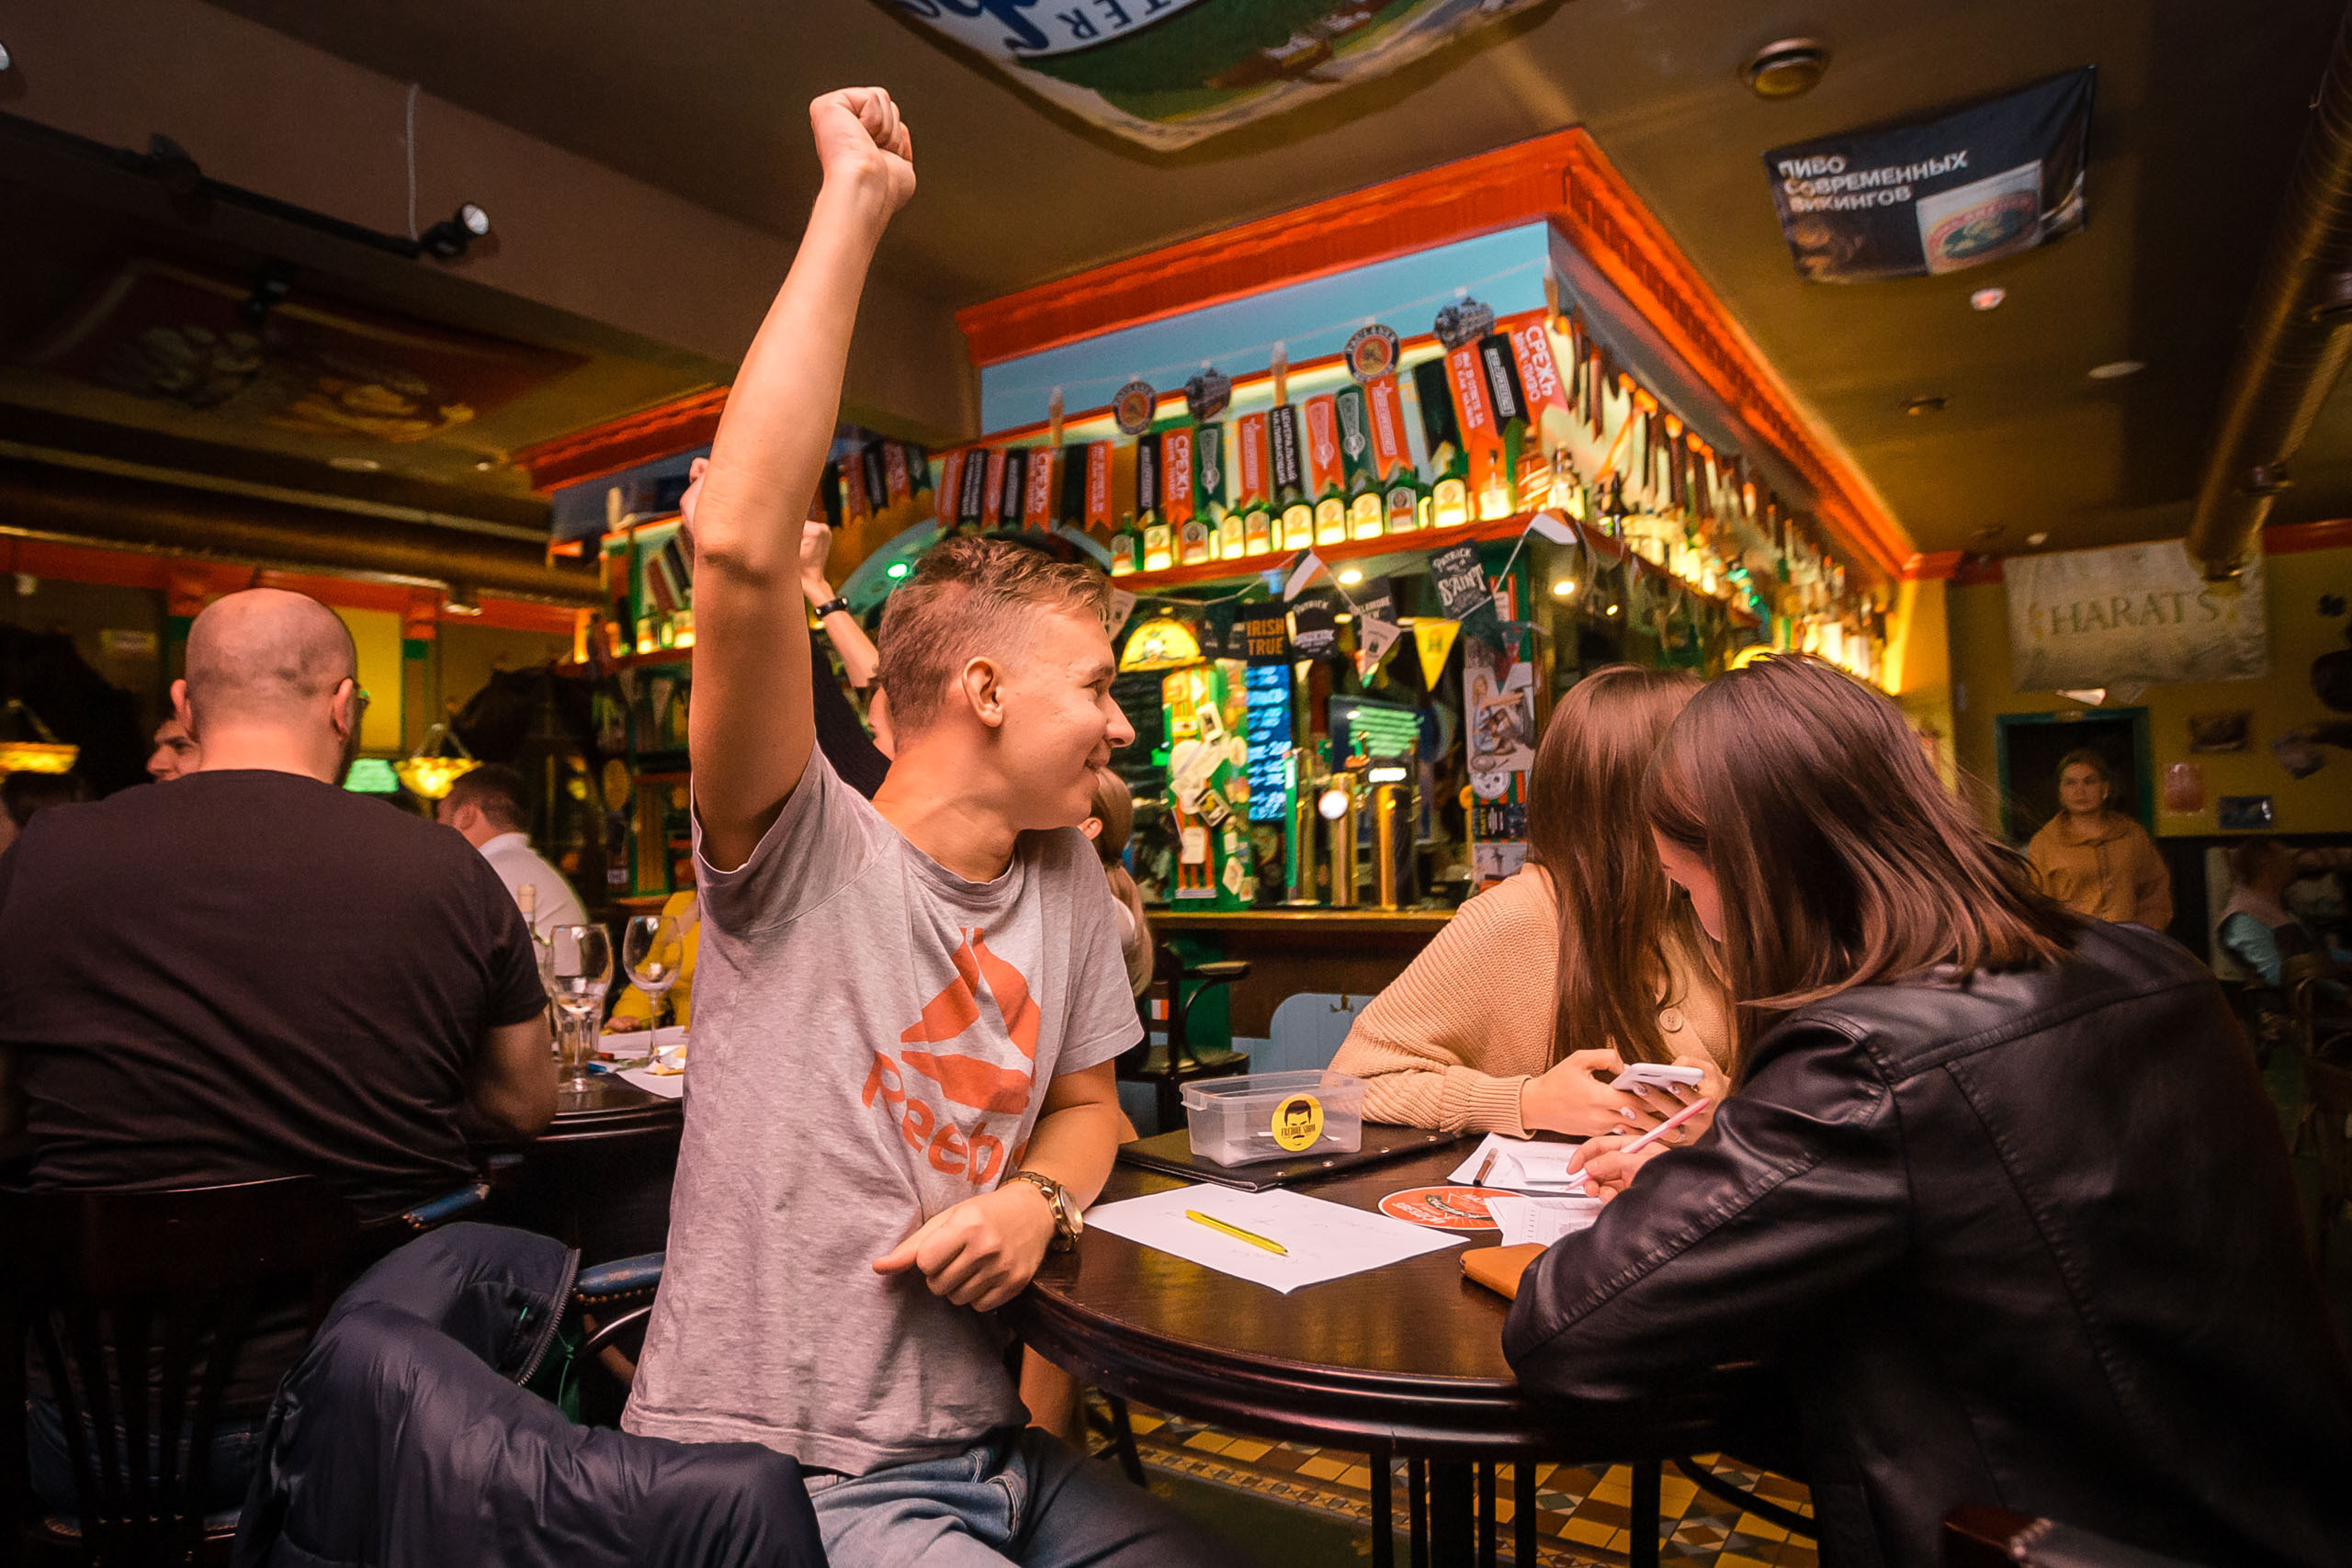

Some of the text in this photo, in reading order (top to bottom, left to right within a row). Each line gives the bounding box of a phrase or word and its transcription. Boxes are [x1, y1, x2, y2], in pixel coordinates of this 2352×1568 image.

[1778, 155, 1847, 178] ПИВО
[1784, 150, 1969, 197] СОВРЕМЕННЫХ
[1789, 185, 1914, 212] ВИКИНГОВ
[1438, 562, 1487, 606] SAINT
[1245, 617, 1285, 637] IRISH
[1248, 637, 1285, 656] TRUE
